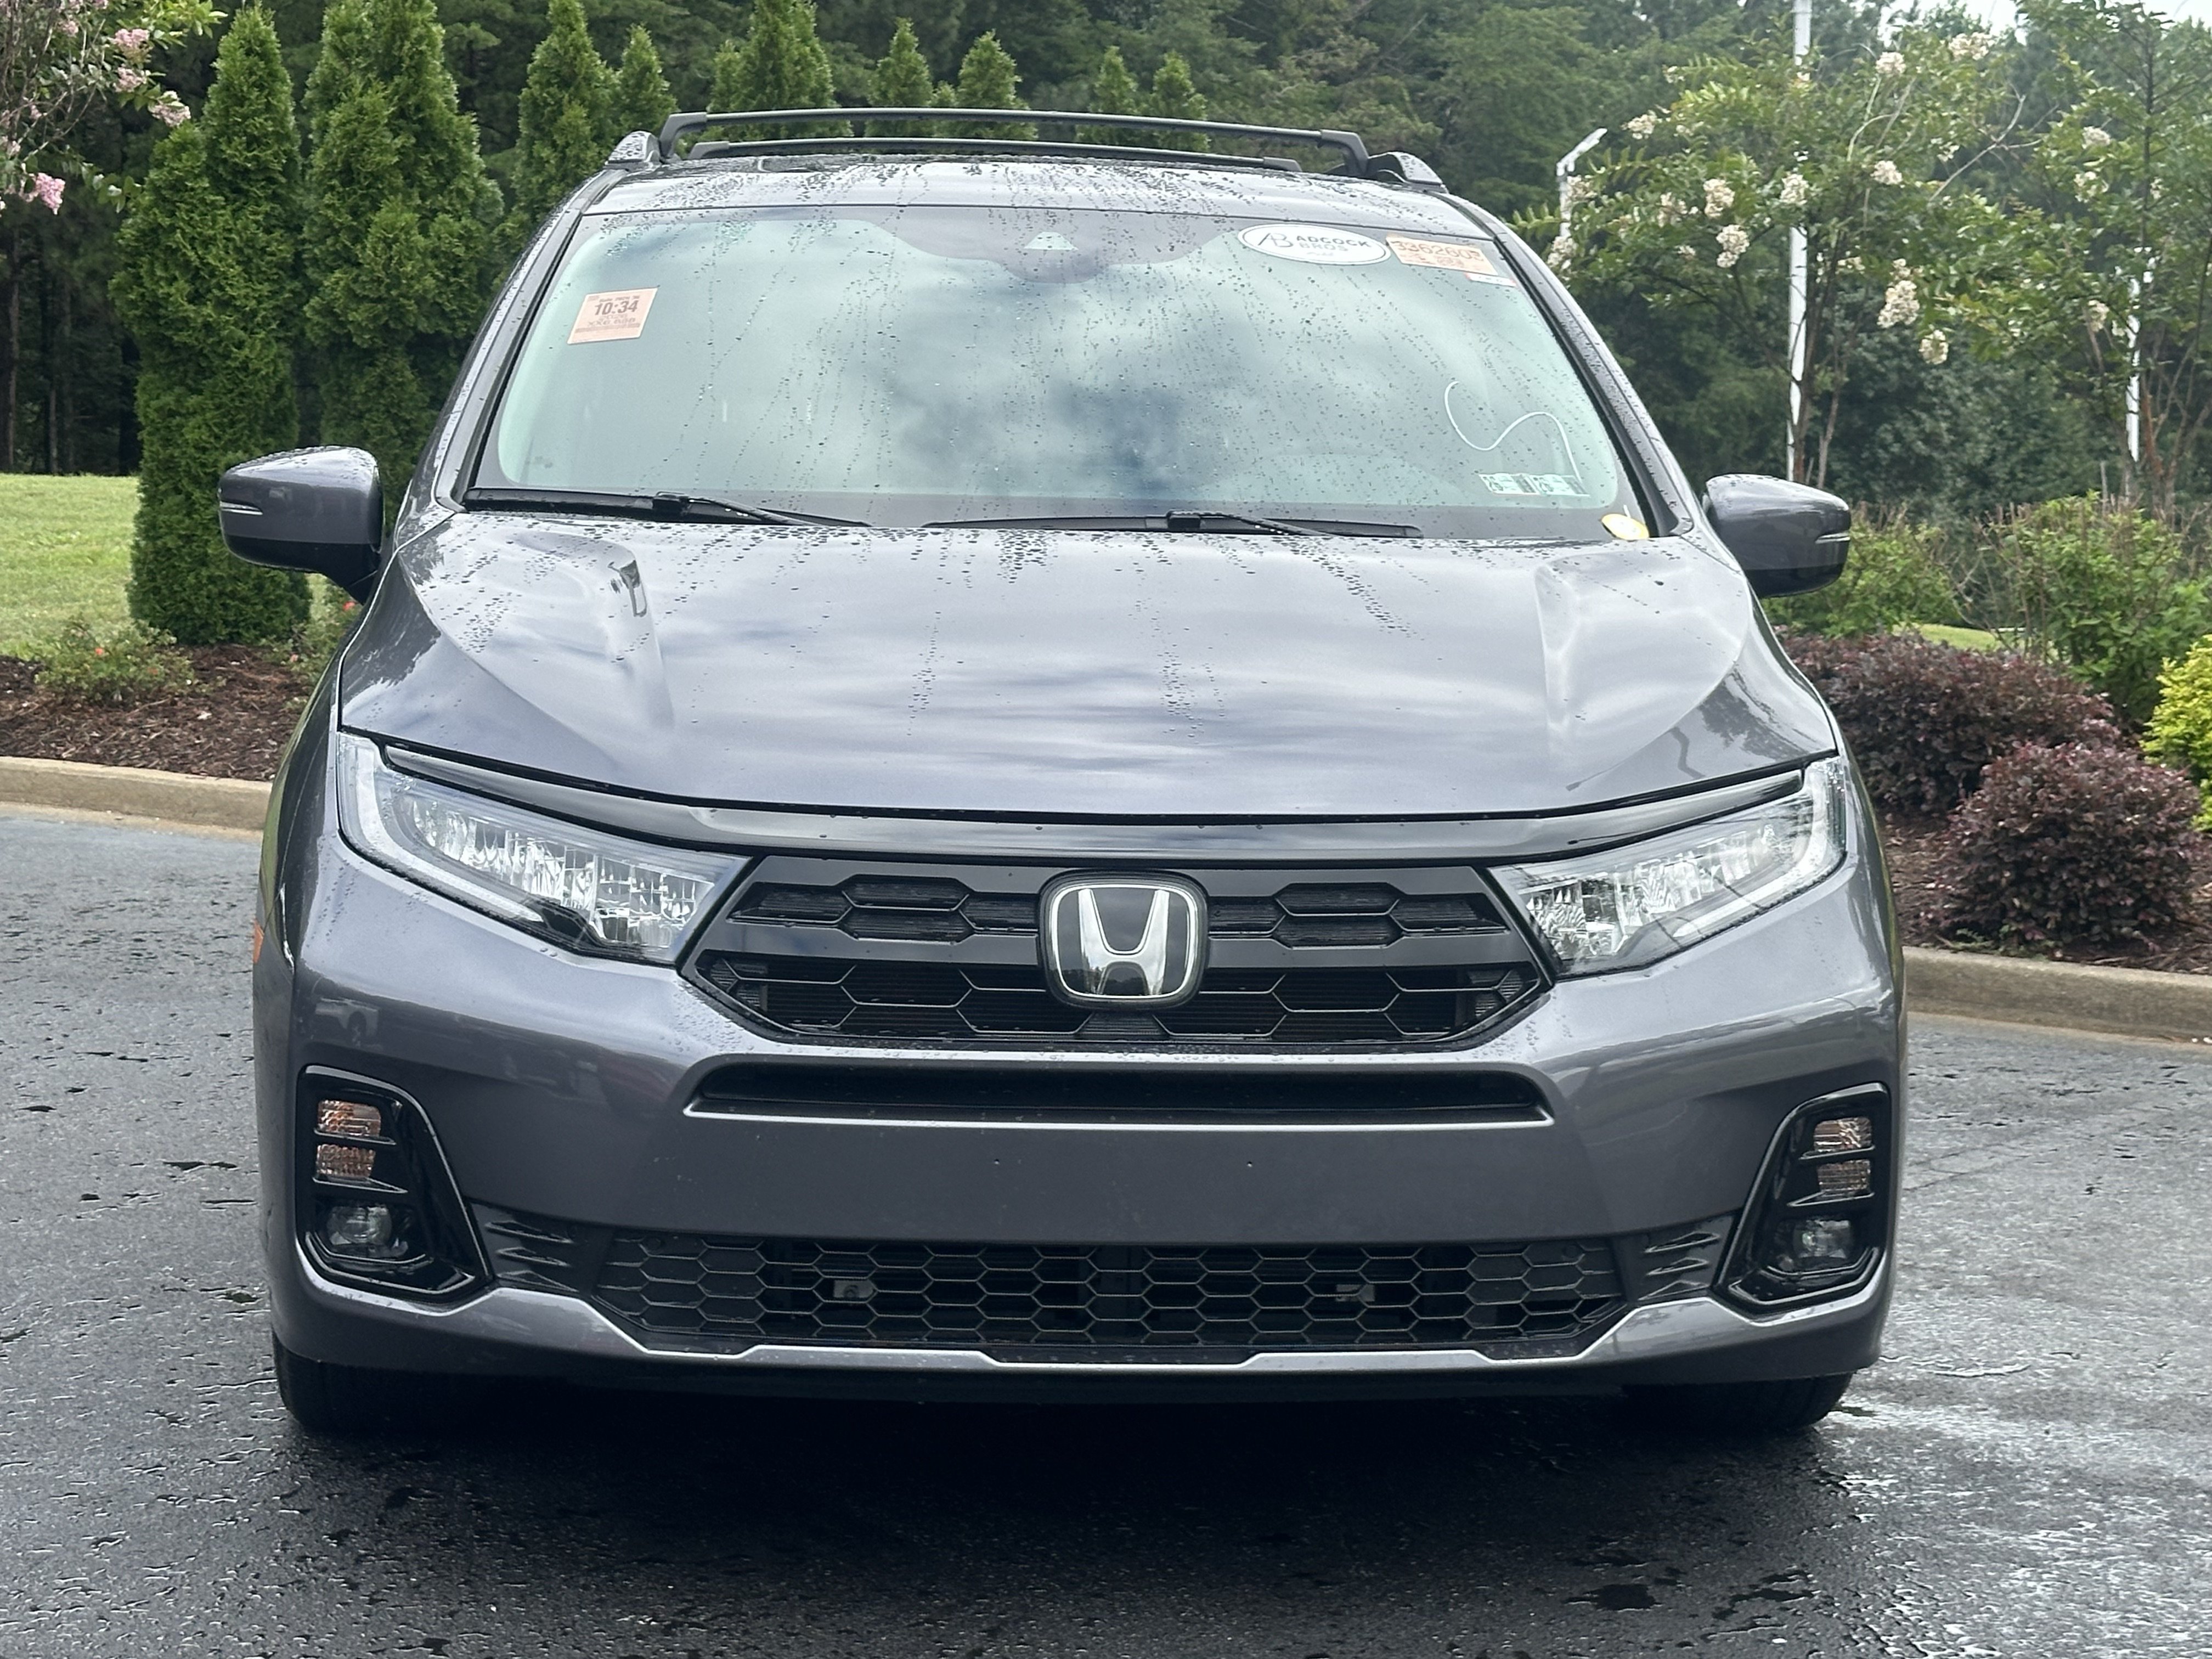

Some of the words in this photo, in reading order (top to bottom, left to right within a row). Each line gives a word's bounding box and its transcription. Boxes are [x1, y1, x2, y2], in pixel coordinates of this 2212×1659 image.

[1296, 235, 1372, 247] ADCOCK
[1299, 242, 1348, 252] BROS
[594, 300, 639, 315] 10:34
